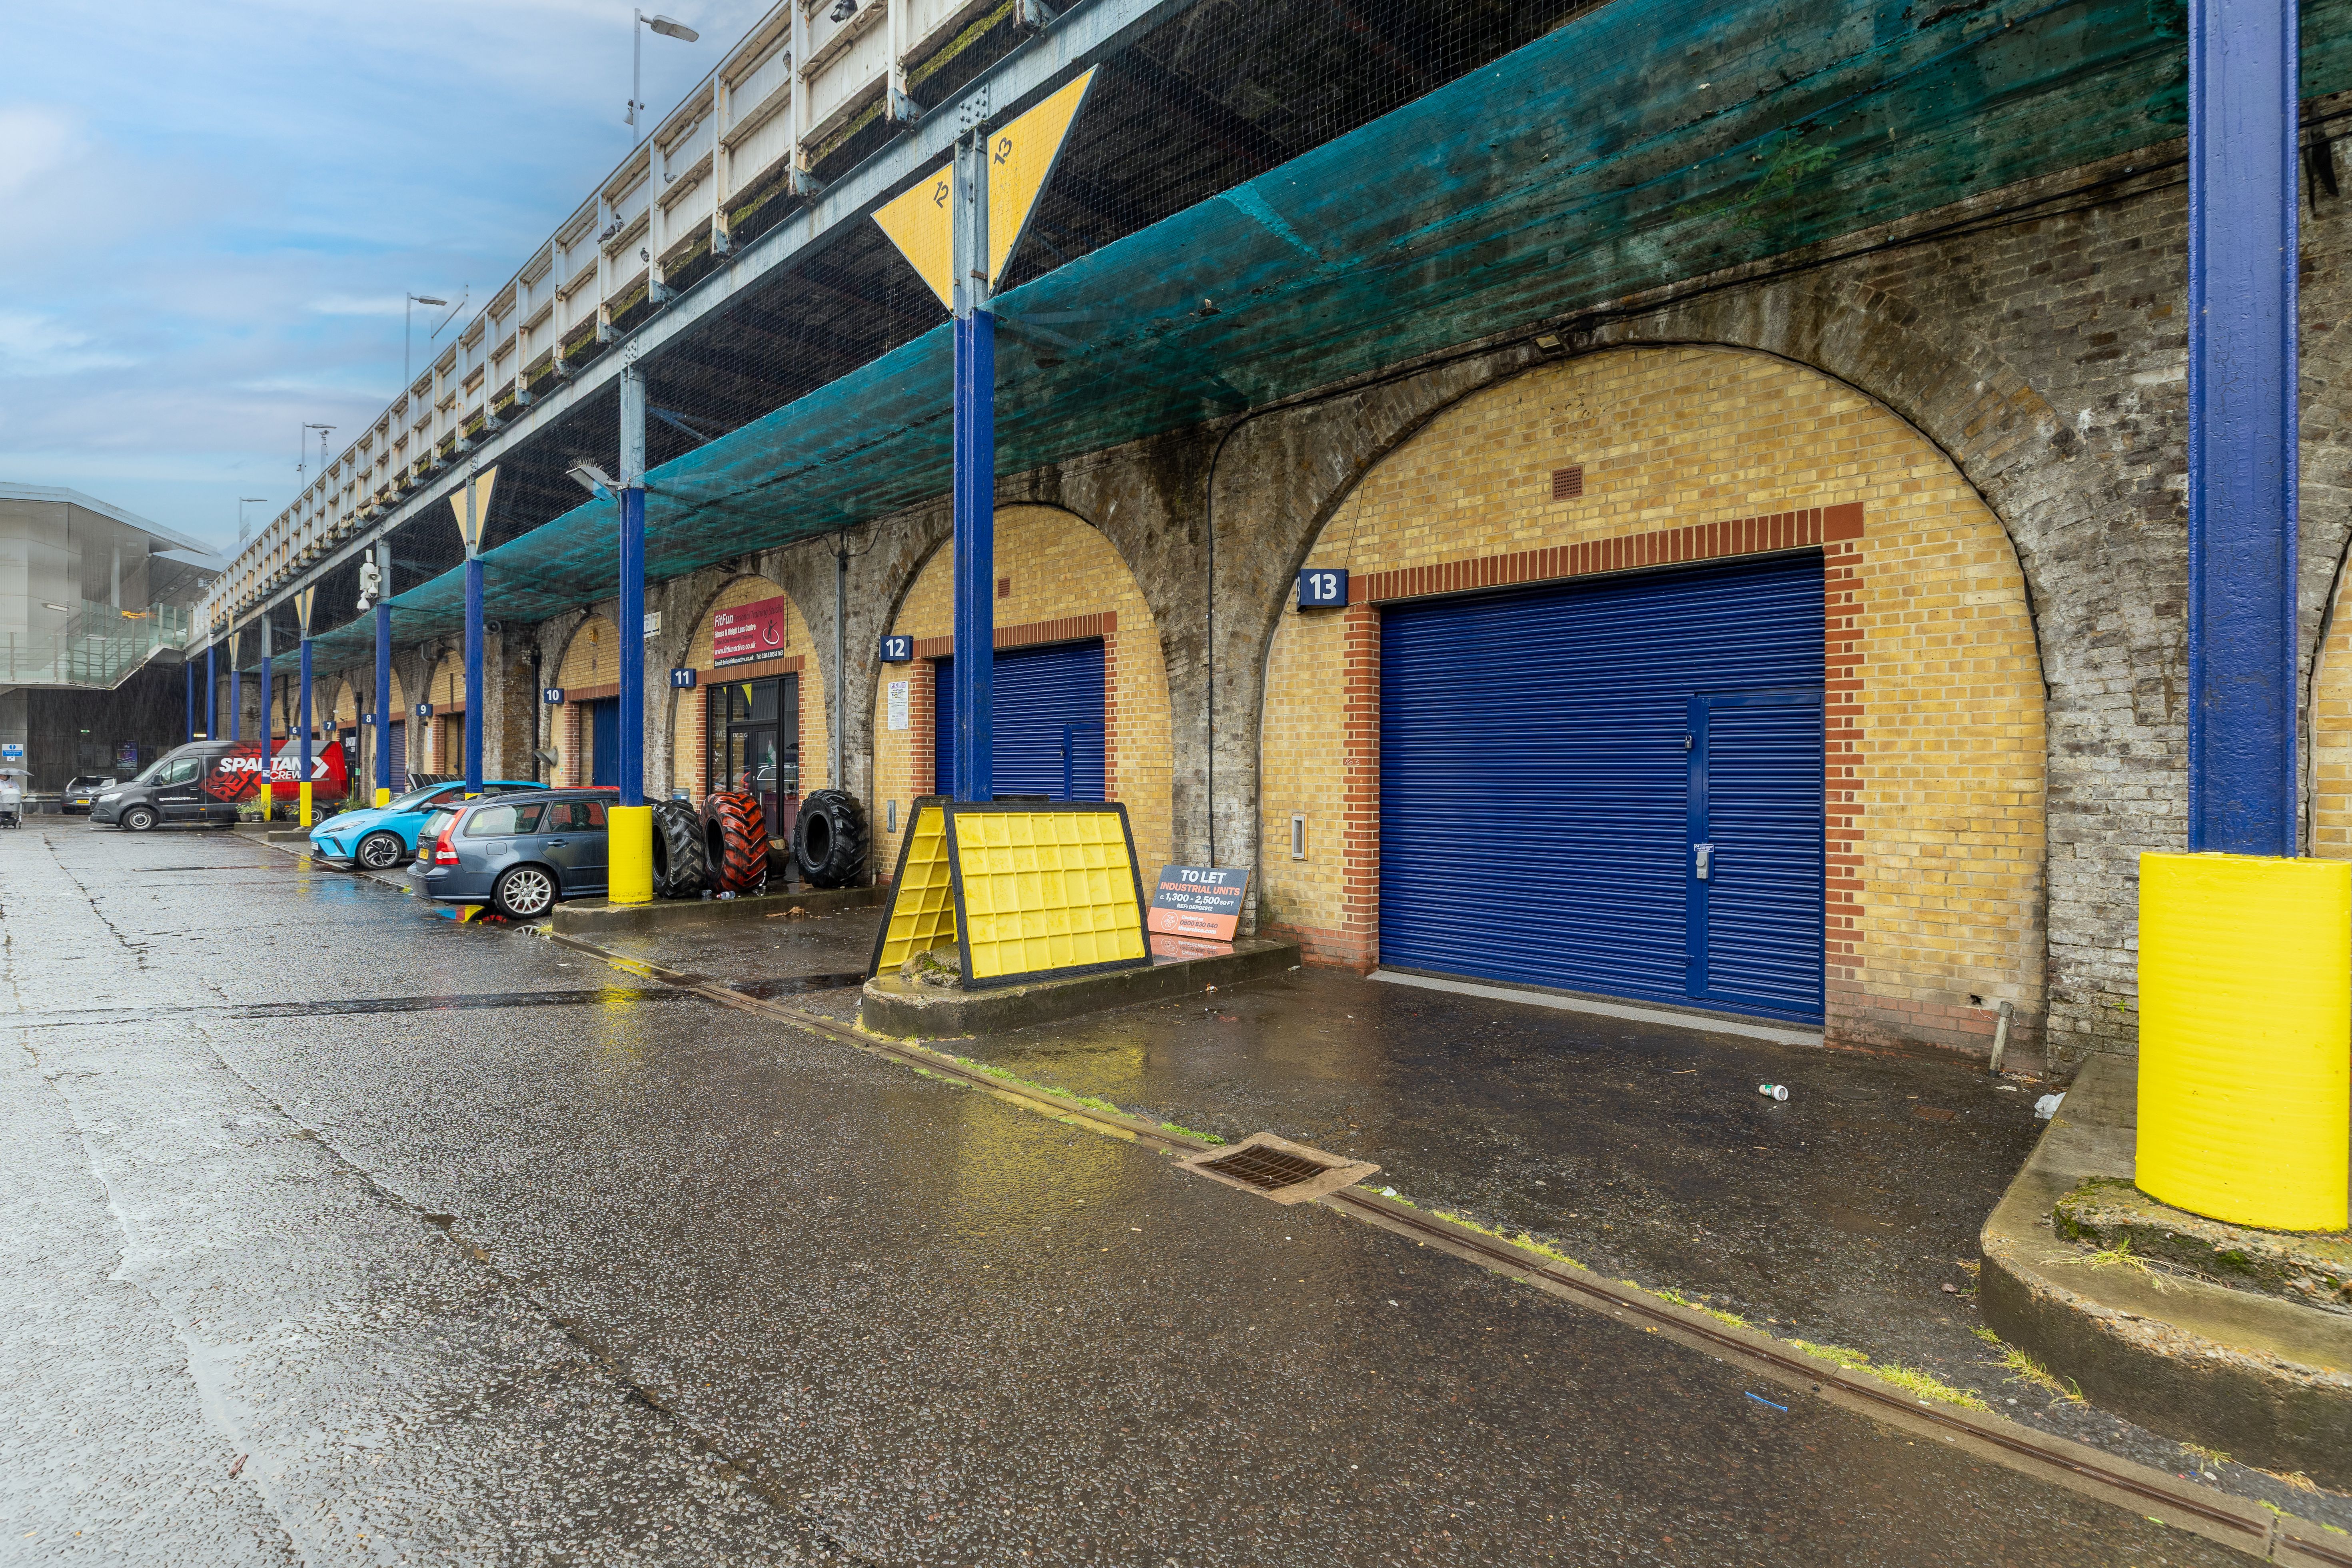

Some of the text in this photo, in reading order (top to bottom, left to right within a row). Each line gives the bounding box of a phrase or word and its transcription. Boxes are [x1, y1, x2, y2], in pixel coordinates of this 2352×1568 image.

[993, 137, 1012, 165] 13
[933, 181, 948, 208] 12
[1310, 574, 1337, 599] 13
[715, 604, 783, 627] FitFun Personal Training Studio
[728, 627, 738, 636] Weight
[715, 641, 756, 655] www.fitfunactive.co.uk
[886, 639, 904, 656] 12
[723, 655, 754, 665] info@fitfunactive.co.uk
[675, 671, 689, 684] 11
[547, 690, 559, 701] 10
[420, 705, 426, 714] 9
[270, 771, 301, 779] CREW
[1181, 869, 1227, 884] TO LET
[1160, 882, 1241, 896] INDUSTRIAL UNITS
[1166, 893, 1189, 902] 1,300
[1194, 895, 1220, 905] 2,500
[1178, 925, 1216, 934] thearchco.com
